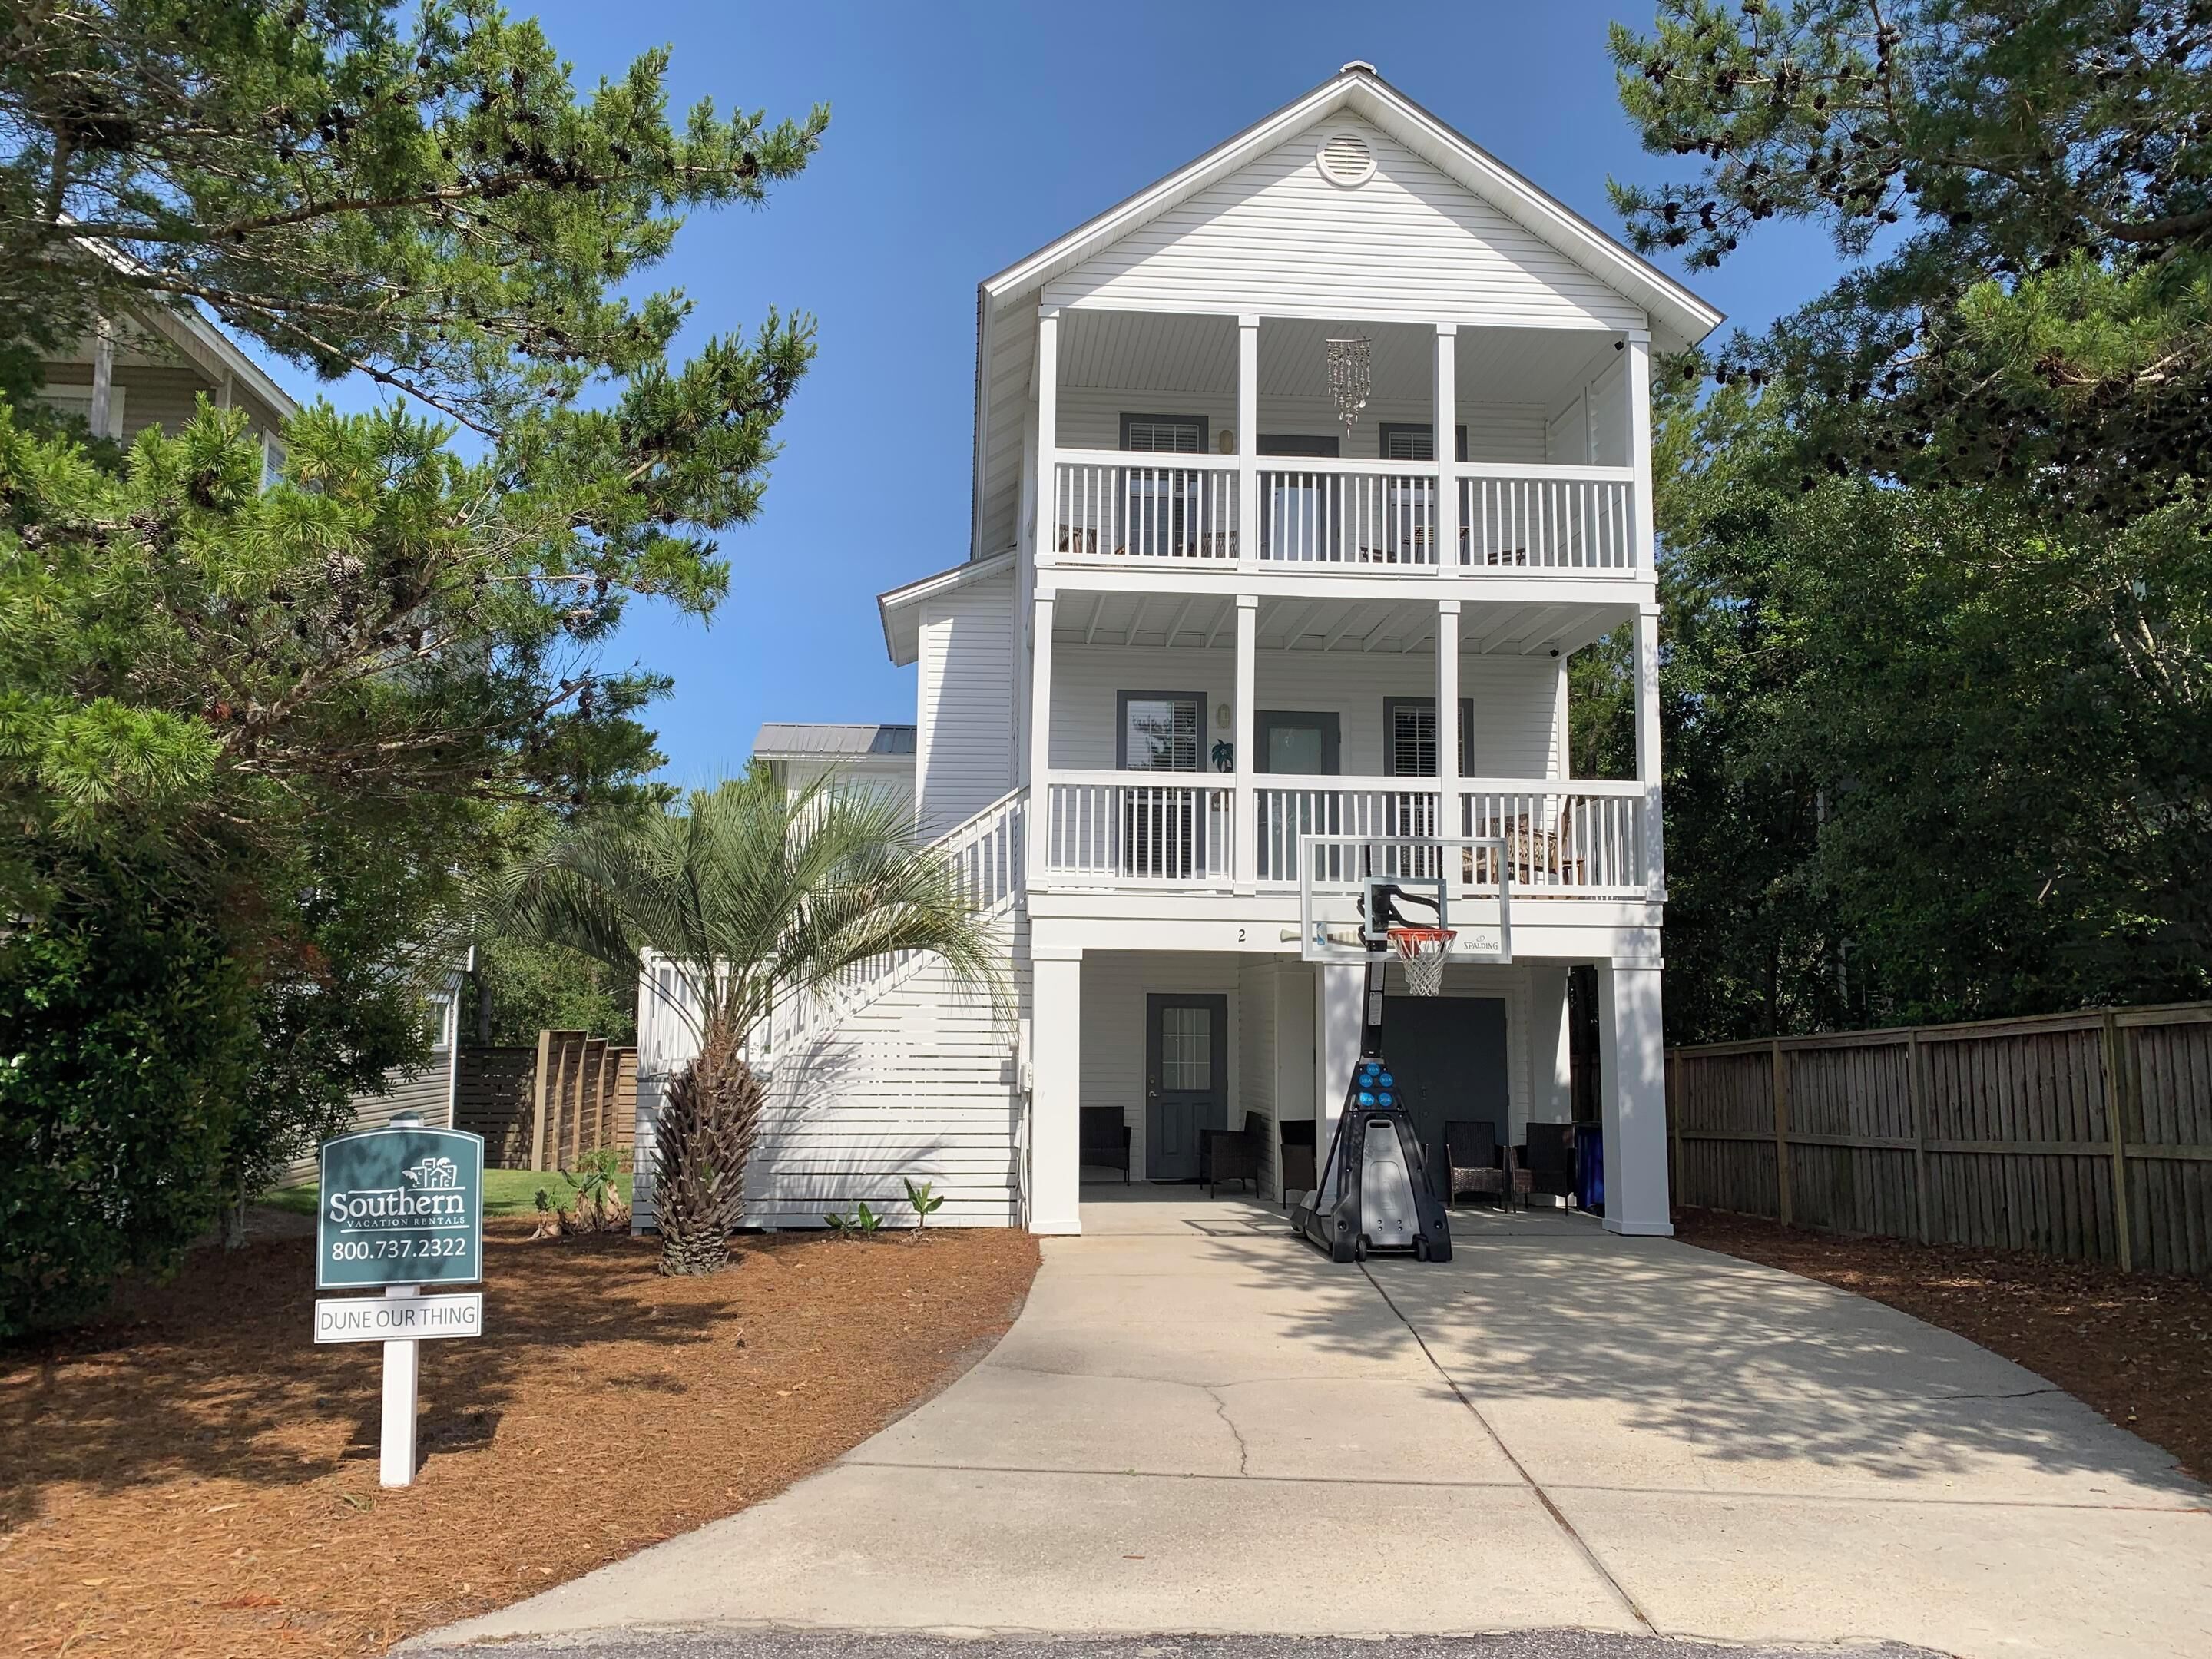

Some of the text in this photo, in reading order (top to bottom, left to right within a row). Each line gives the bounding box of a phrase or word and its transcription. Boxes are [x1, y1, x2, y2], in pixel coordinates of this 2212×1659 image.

[1238, 929, 1246, 942] 2
[1463, 941, 1498, 950] SPALDING
[329, 1186, 465, 1223] Southern
[347, 1217, 465, 1228] VACATION RENTALS
[332, 1237, 466, 1260] 800.737.2322
[321, 1306, 475, 1330] DUNE OUR THING
